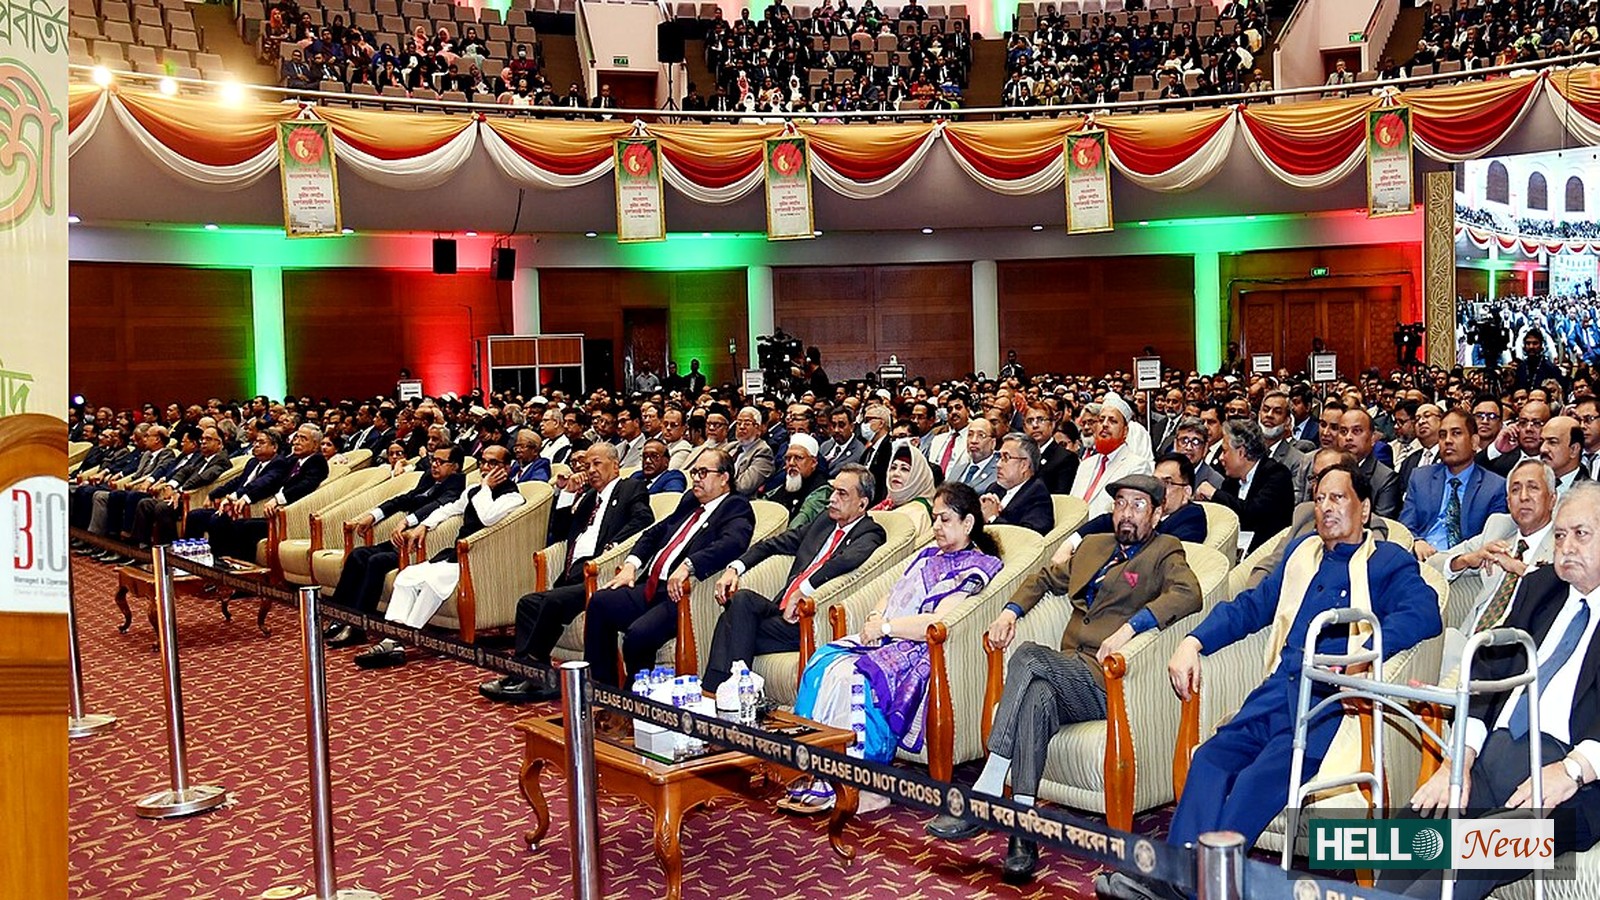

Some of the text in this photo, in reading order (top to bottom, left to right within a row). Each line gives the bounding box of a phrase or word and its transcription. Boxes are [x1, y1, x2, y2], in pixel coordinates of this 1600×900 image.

[594, 689, 679, 727] PLEASE DO NOT CROSS
[811, 754, 942, 807] PLEASE DO NOT CROSS
[1109, 836, 1125, 860] না
